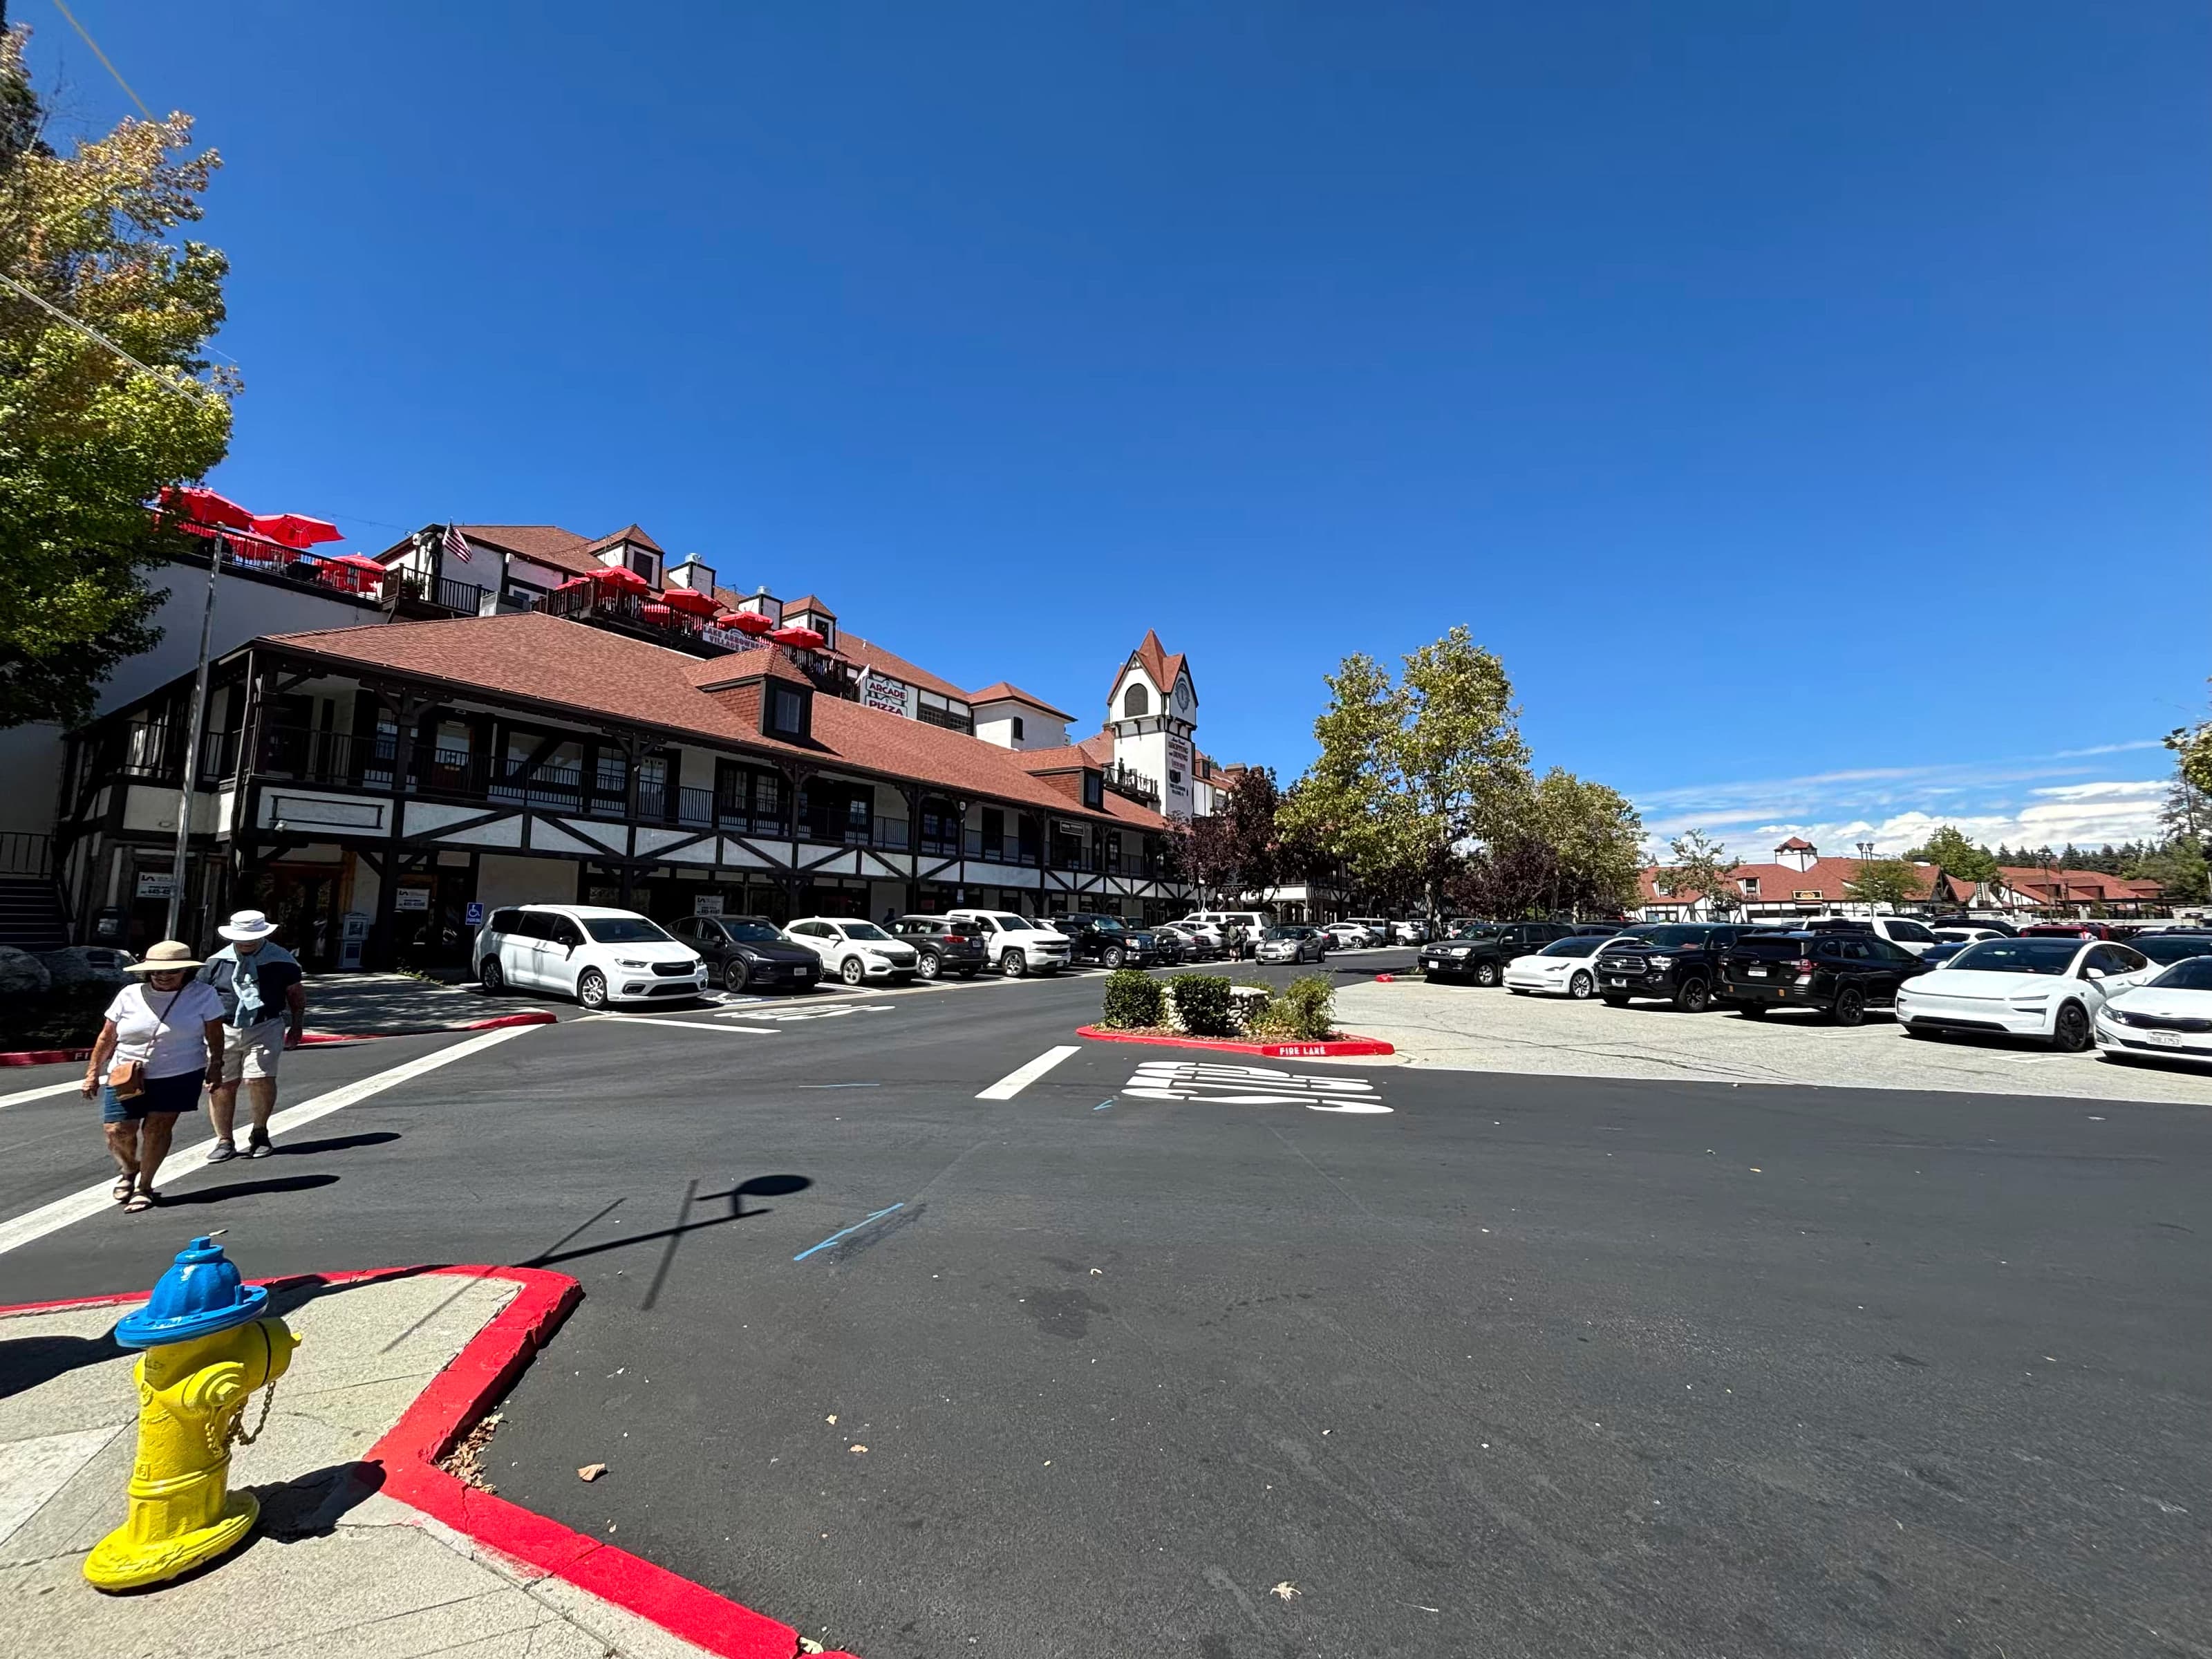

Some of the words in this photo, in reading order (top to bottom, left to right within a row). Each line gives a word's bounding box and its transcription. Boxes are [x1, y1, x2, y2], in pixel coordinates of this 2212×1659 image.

[704, 626, 722, 638] LAKE
[724, 633, 766, 649] ARROWHEA
[709, 635, 740, 650] VILLAGE
[869, 682, 906, 700] ARCADE
[869, 700, 903, 715] PIZZA
[1280, 1047, 1300, 1056] FIRE
[1303, 1046, 1325, 1055] LANE
